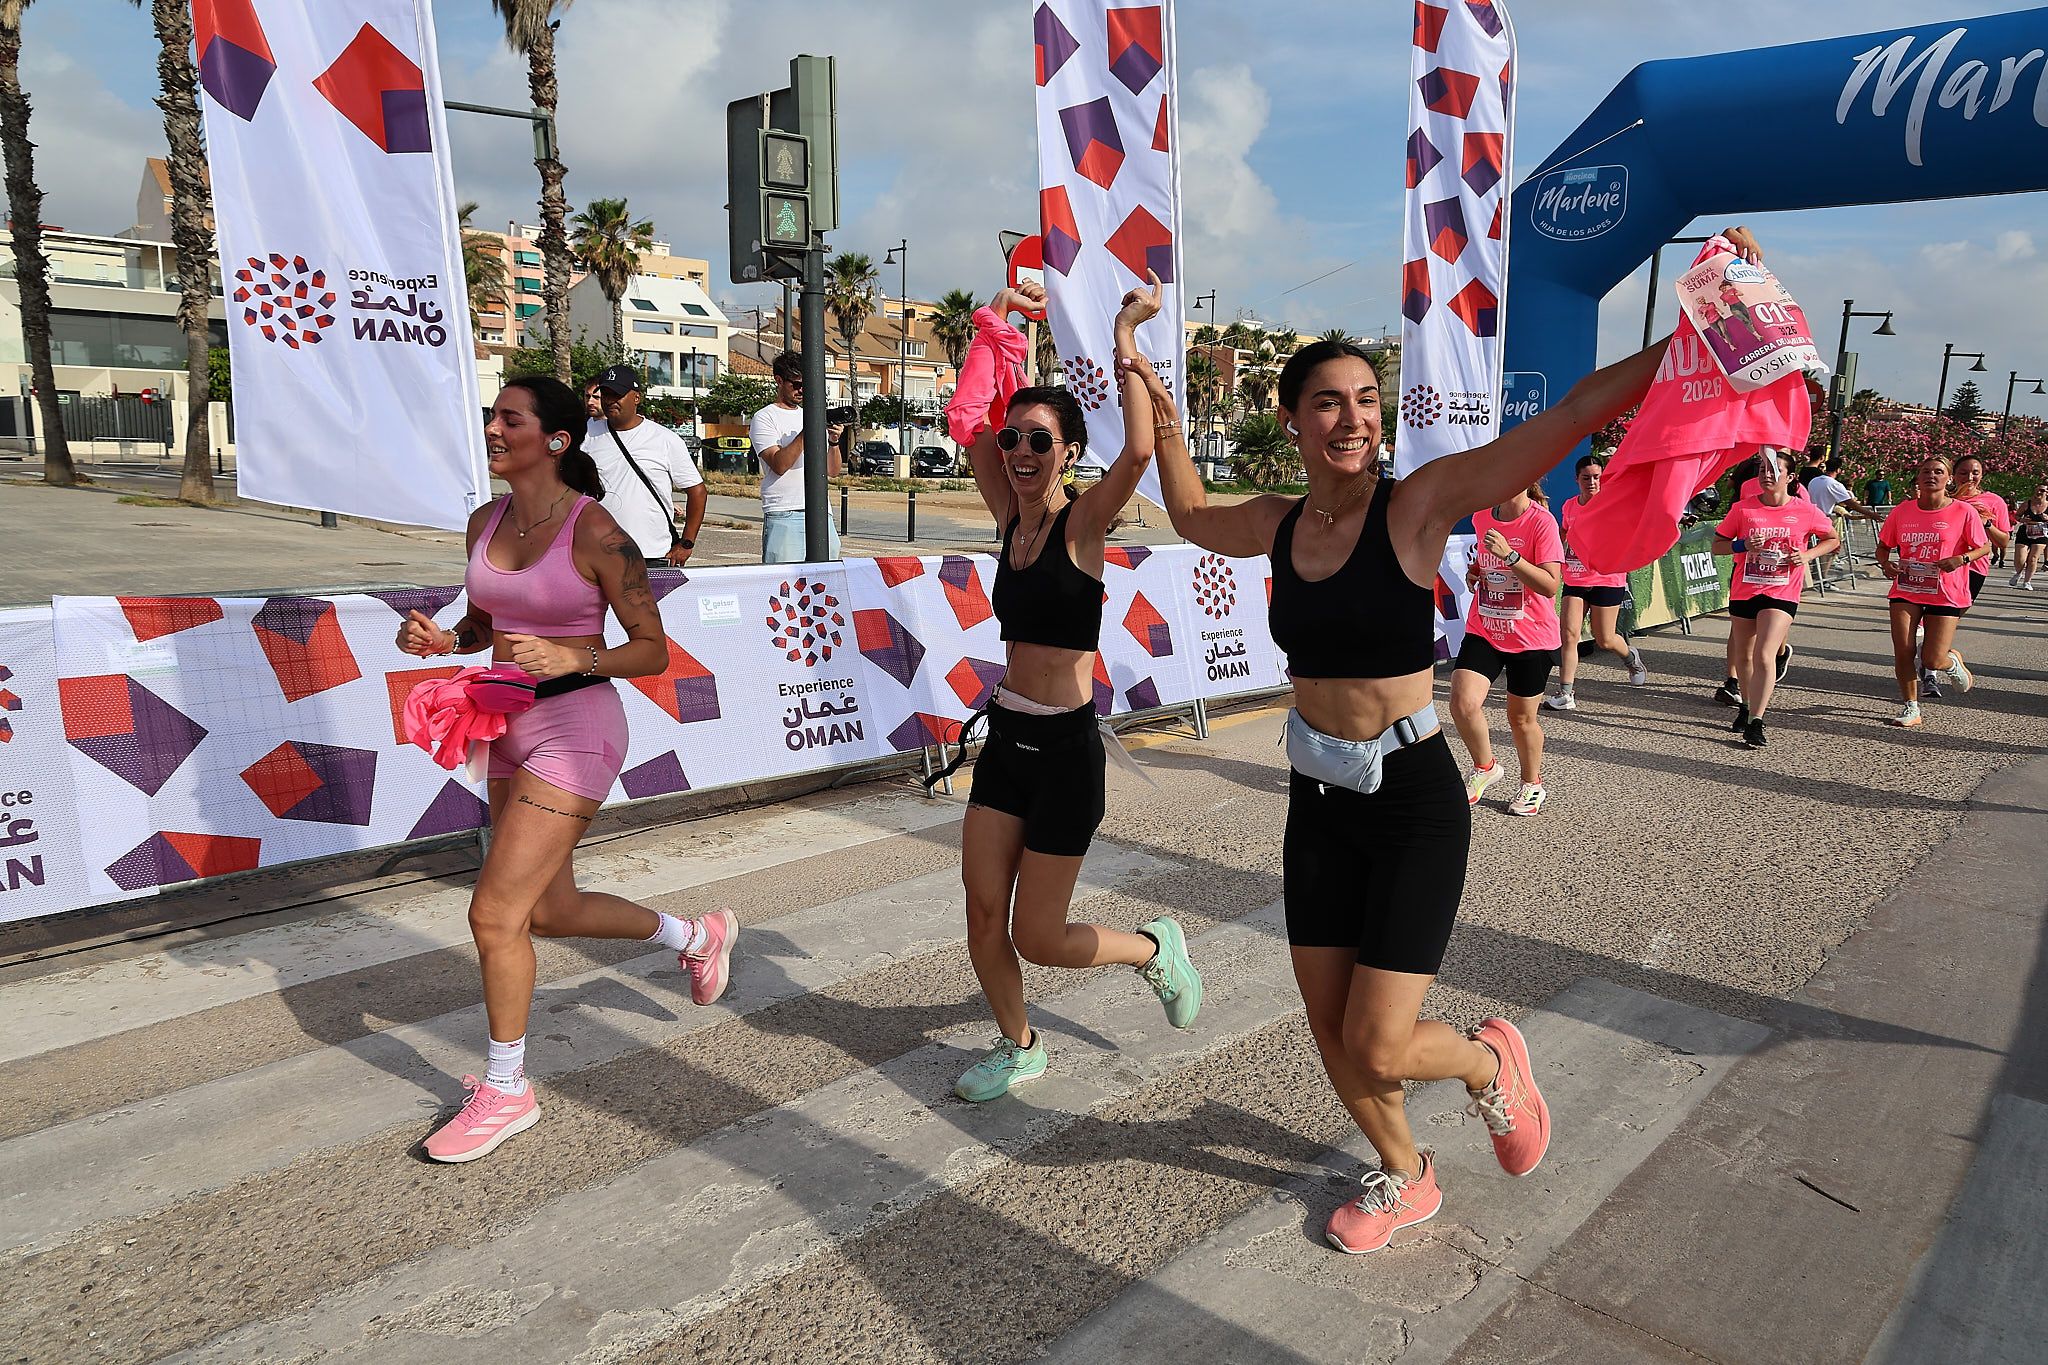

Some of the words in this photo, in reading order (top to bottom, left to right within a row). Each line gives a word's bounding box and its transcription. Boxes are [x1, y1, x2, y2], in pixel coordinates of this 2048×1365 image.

[1538, 183, 1620, 222] Marlene
[1539, 220, 1554, 233] HIJA
[1556, 228, 1567, 236] DE
[1587, 218, 1611, 234] ALPES
[1686, 271, 1719, 293] SUMA
[1738, 342, 1777, 365] CARRERA
[1750, 351, 1797, 381] OYSHO
[1682, 376, 1722, 403] 2026
[1901, 532, 1940, 543] CARRERA
[1759, 564, 1777, 572] 016
[1488, 590, 1505, 600] 016
[1201, 628, 1243, 642] Experience
[1481, 616, 1516, 634] MUJER
[1207, 660, 1250, 682] OMAN
[778, 678, 854, 697] Experience
[785, 720, 865, 752] OMAN
